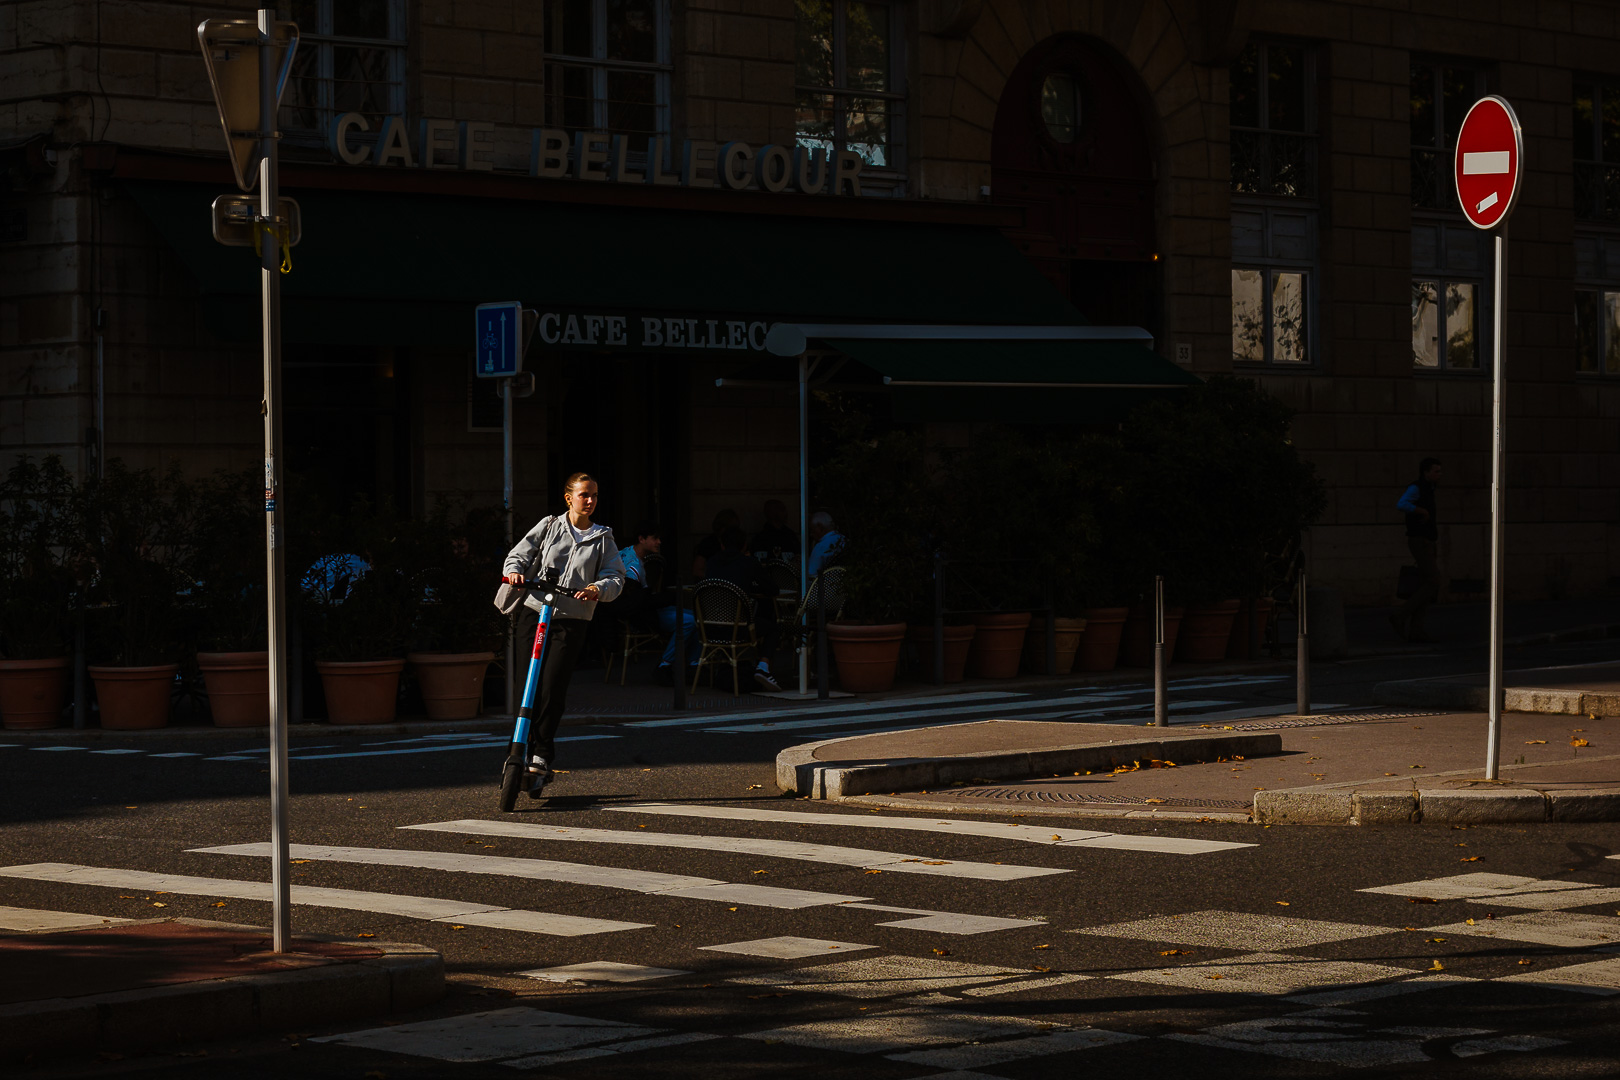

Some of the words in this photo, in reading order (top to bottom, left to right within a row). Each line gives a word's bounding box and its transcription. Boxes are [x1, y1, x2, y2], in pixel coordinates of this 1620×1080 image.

[330, 112, 495, 171] CAFE
[530, 128, 863, 197] BELLECOUR
[538, 313, 627, 346] CAFE
[1179, 347, 1189, 360] 33
